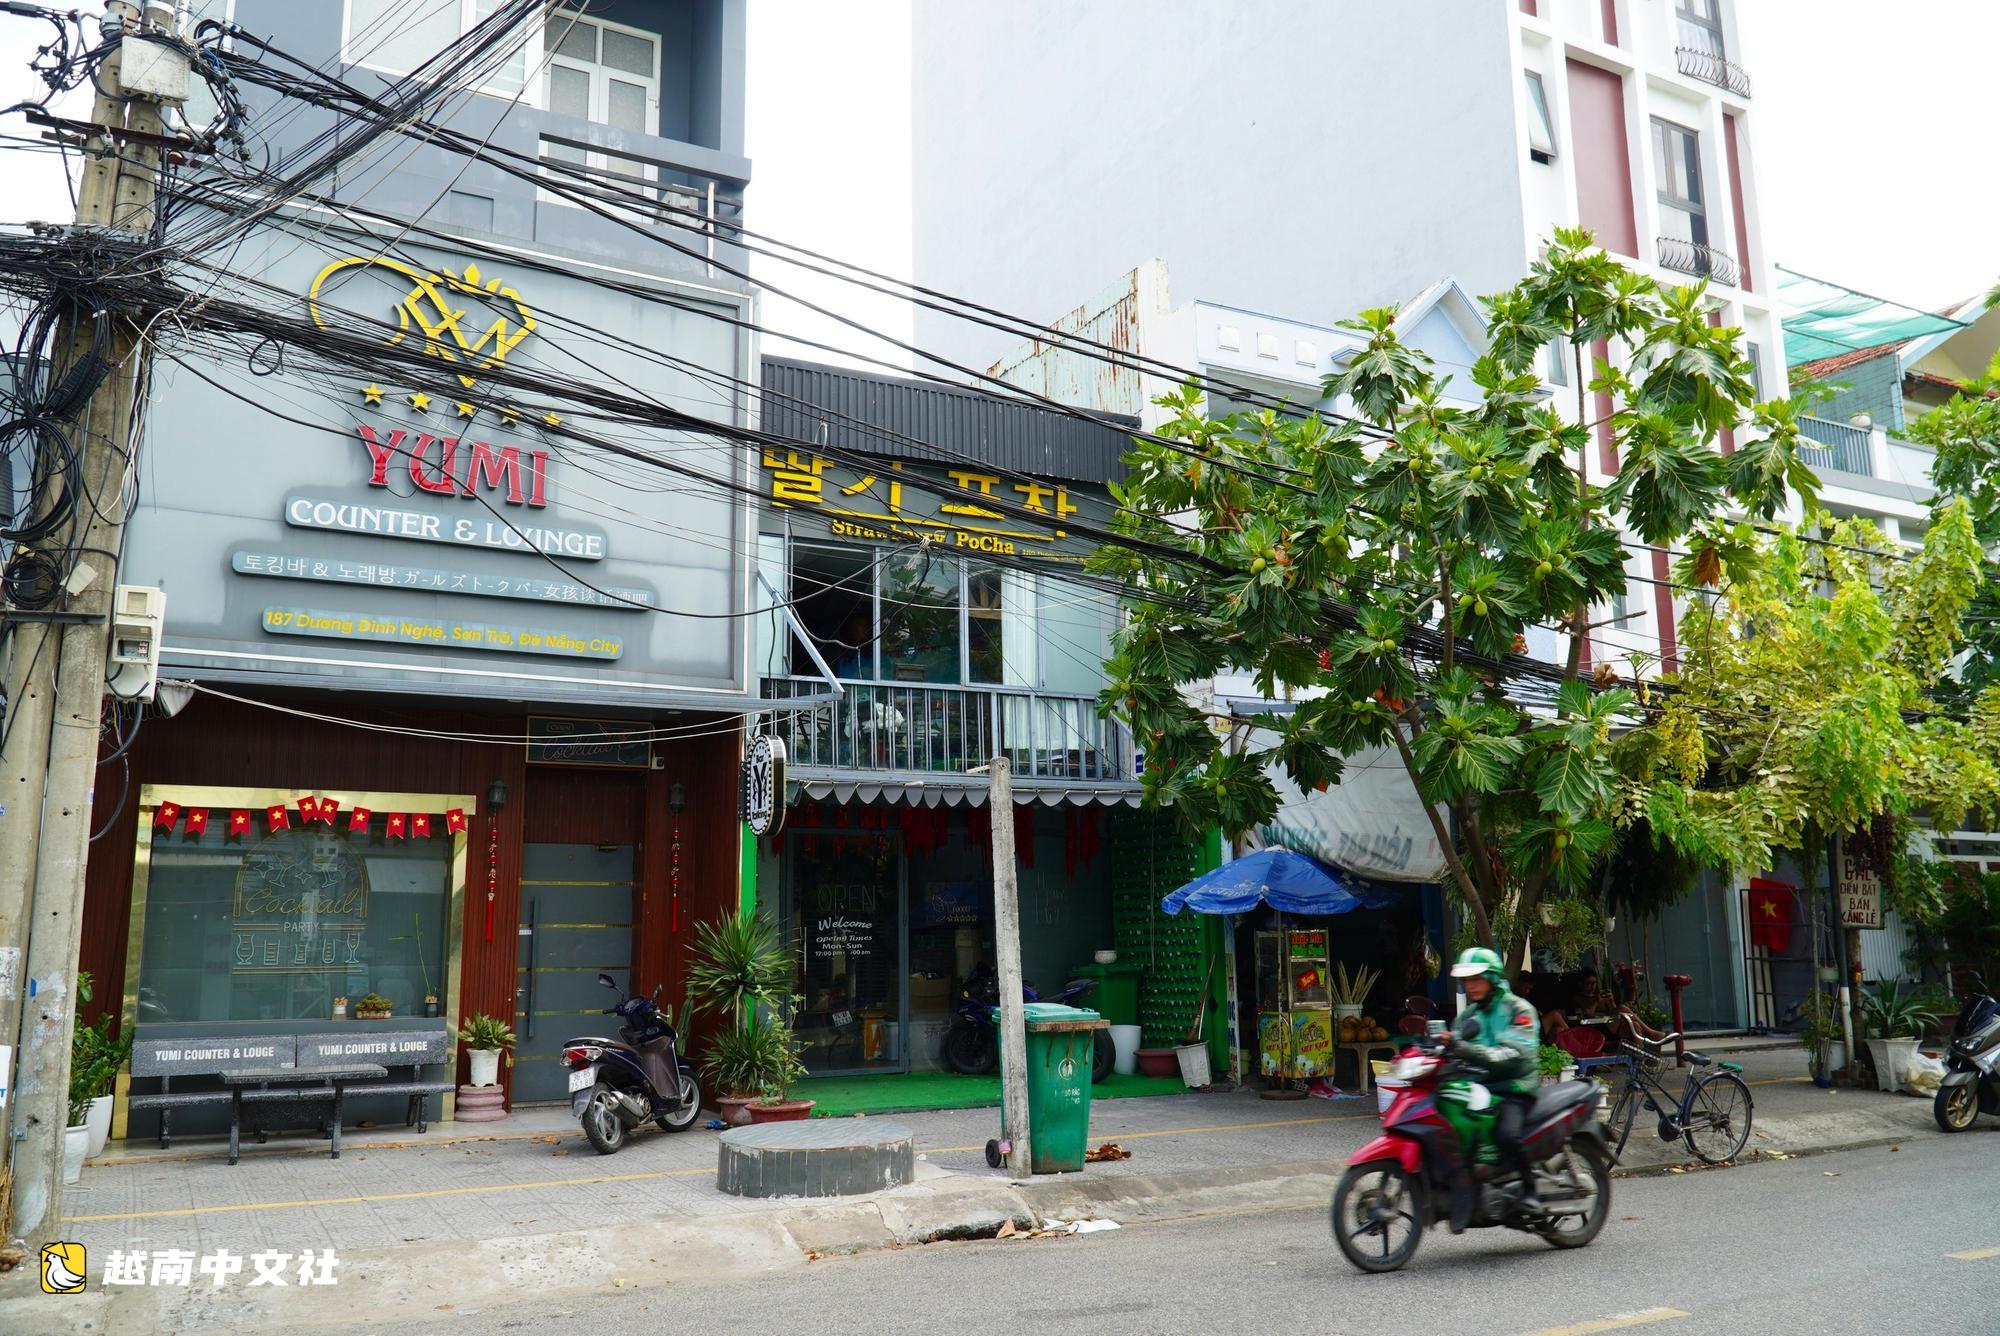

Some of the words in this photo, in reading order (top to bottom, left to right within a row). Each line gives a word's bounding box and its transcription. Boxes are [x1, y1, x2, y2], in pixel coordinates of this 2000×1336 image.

[357, 424, 549, 507] YUMI
[291, 499, 441, 539] COUNTER
[454, 519, 477, 541] &
[486, 523, 602, 557] LOUNGE
[956, 532, 1014, 555] PoCha
[244, 555, 306, 576] 토킹바
[312, 563, 328, 577] &
[266, 611, 293, 626] 187
[590, 638, 619, 656] City
[283, 922, 320, 932] PARTY
[818, 916, 873, 931] Welcome
[155, 1050, 181, 1061] YUMI
[184, 1048, 230, 1060] COUNTER
[233, 1048, 240, 1058] &
[243, 1047, 275, 1057] LOUGE
[319, 1045, 342, 1055] YUMI
[345, 1043, 387, 1054] COUNTER
[390, 1043, 397, 1053] &
[399, 1041, 428, 1051] LOUGE
